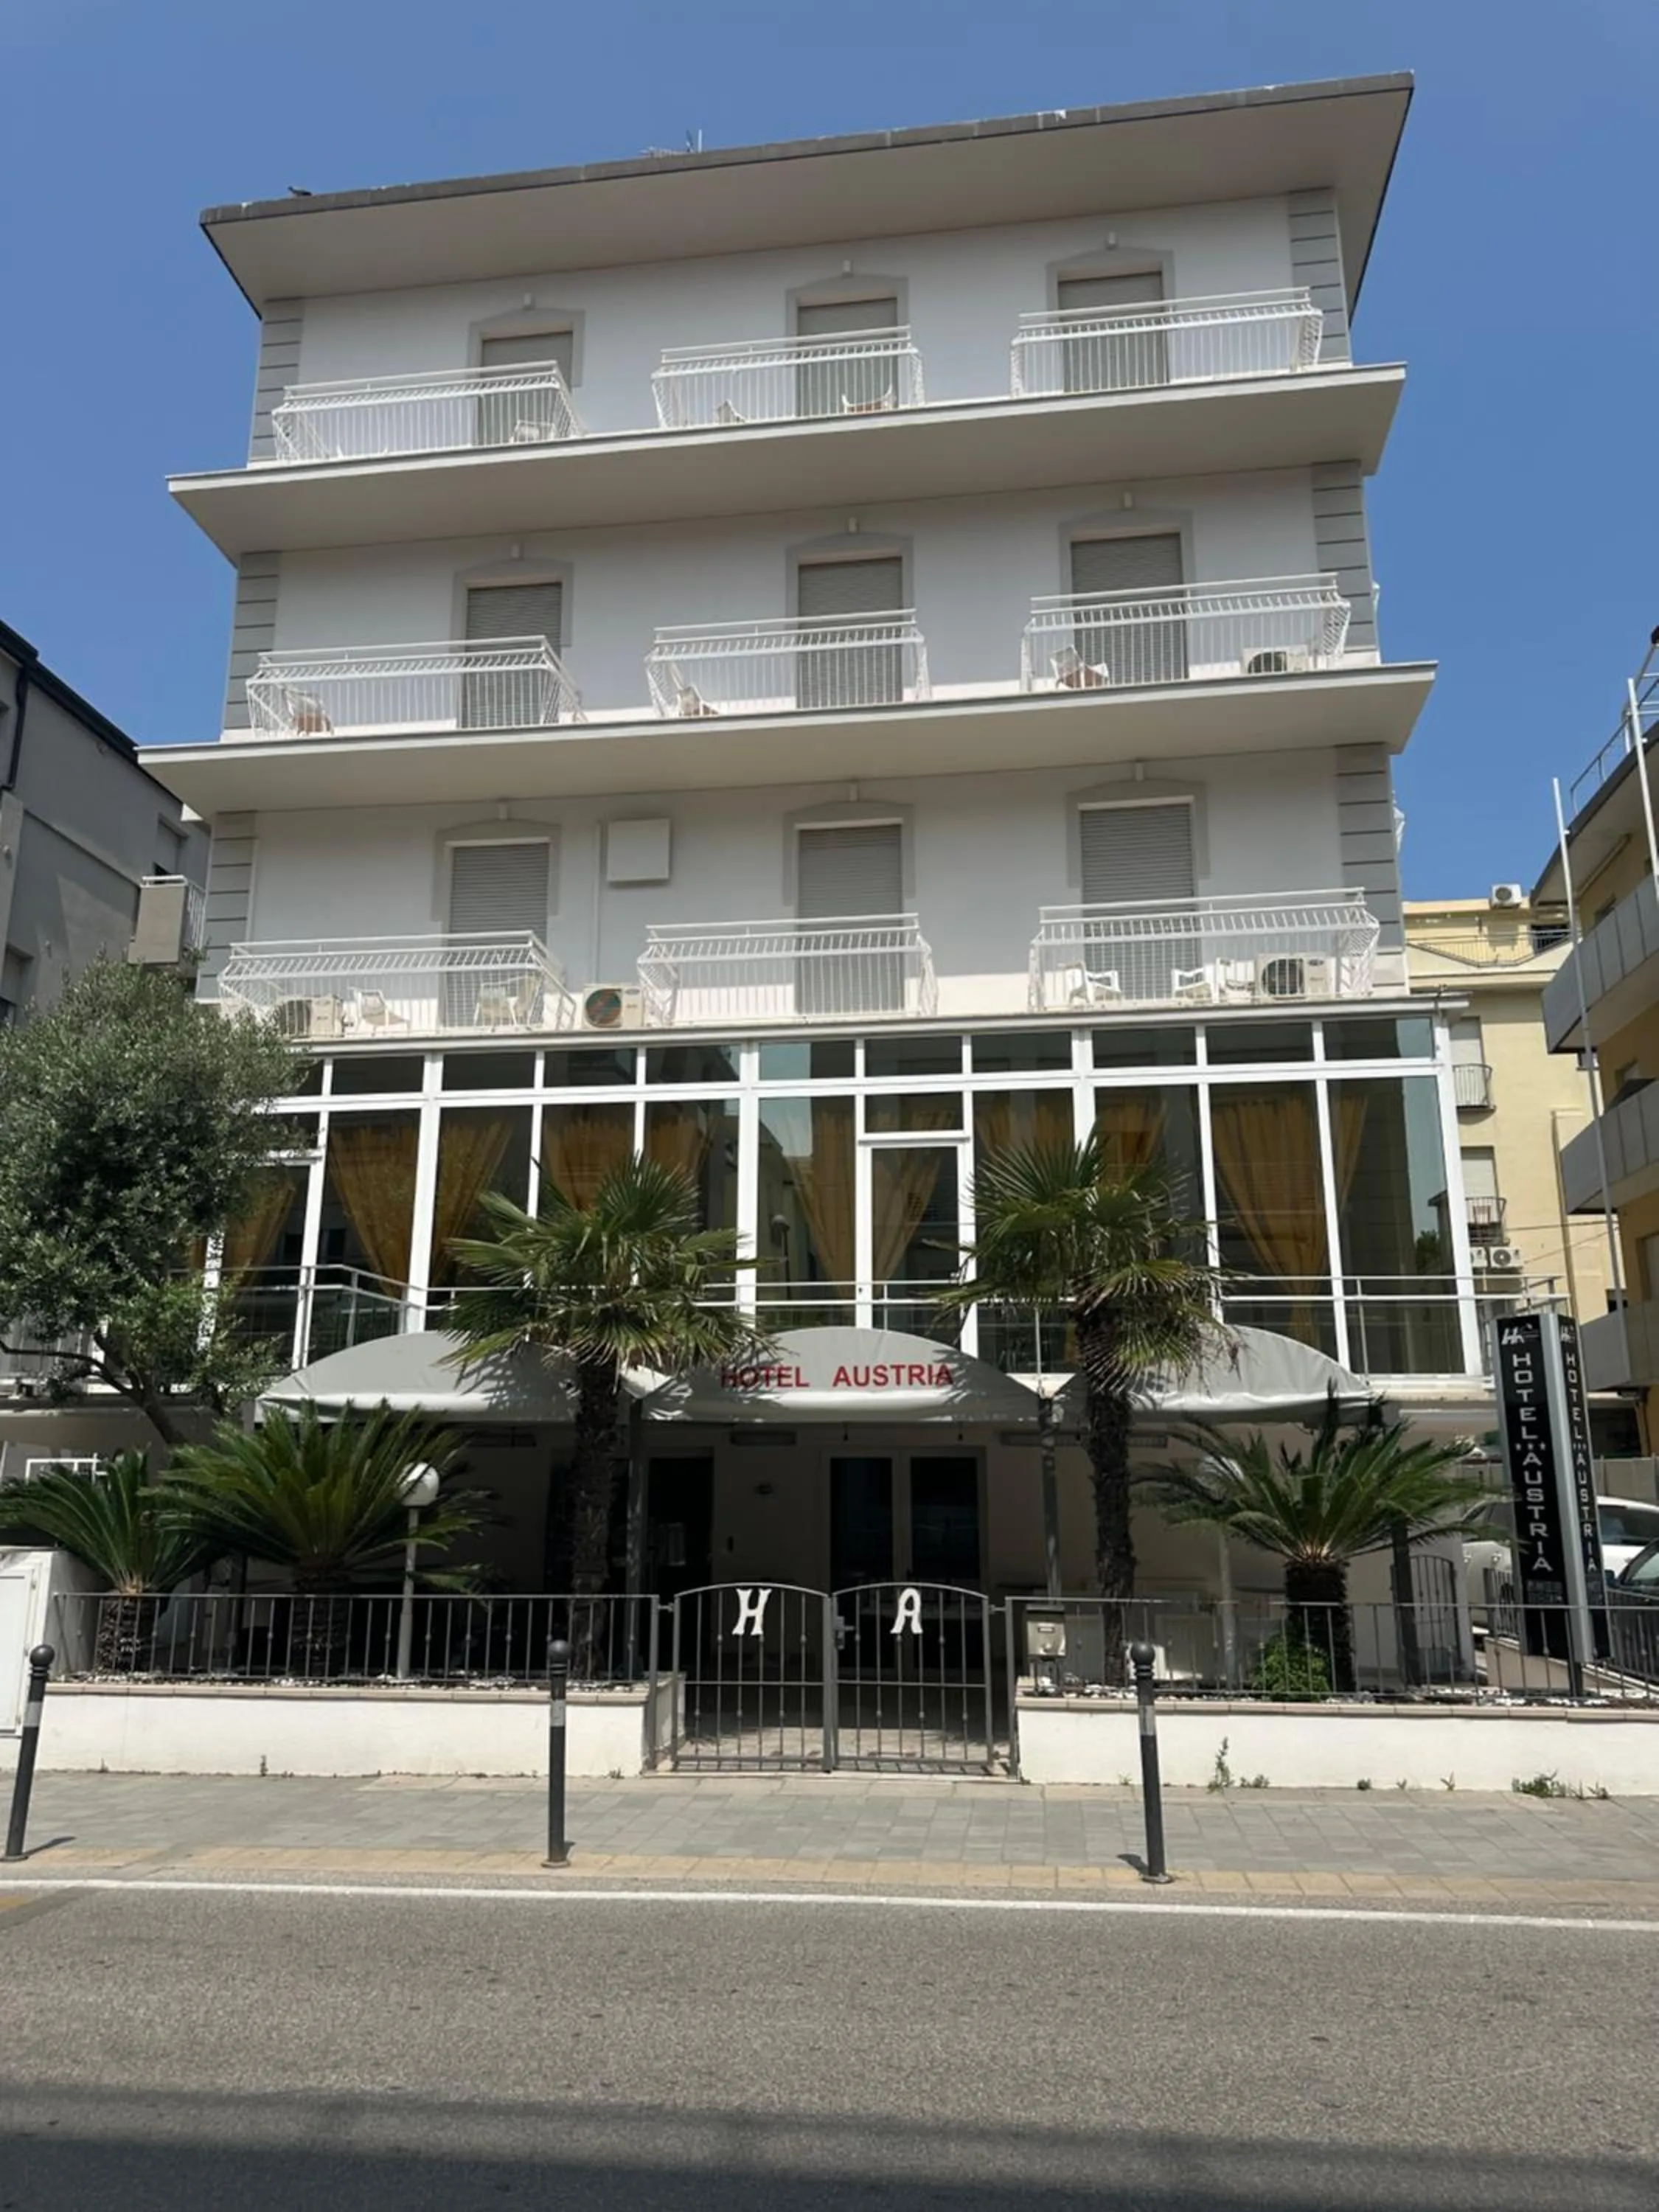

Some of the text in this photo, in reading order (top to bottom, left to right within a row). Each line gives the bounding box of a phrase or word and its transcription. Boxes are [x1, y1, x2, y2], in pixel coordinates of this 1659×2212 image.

[720, 1364, 954, 1388] HOTEL AUSTRIA
[1512, 1353, 1537, 1441] HOTEL
[1565, 1352, 1583, 1441] HOTEL
[1577, 1452, 1597, 1572] AUSTRIA
[1522, 1453, 1552, 1571] AUSTRIA
[732, 1587, 923, 1635] H A
